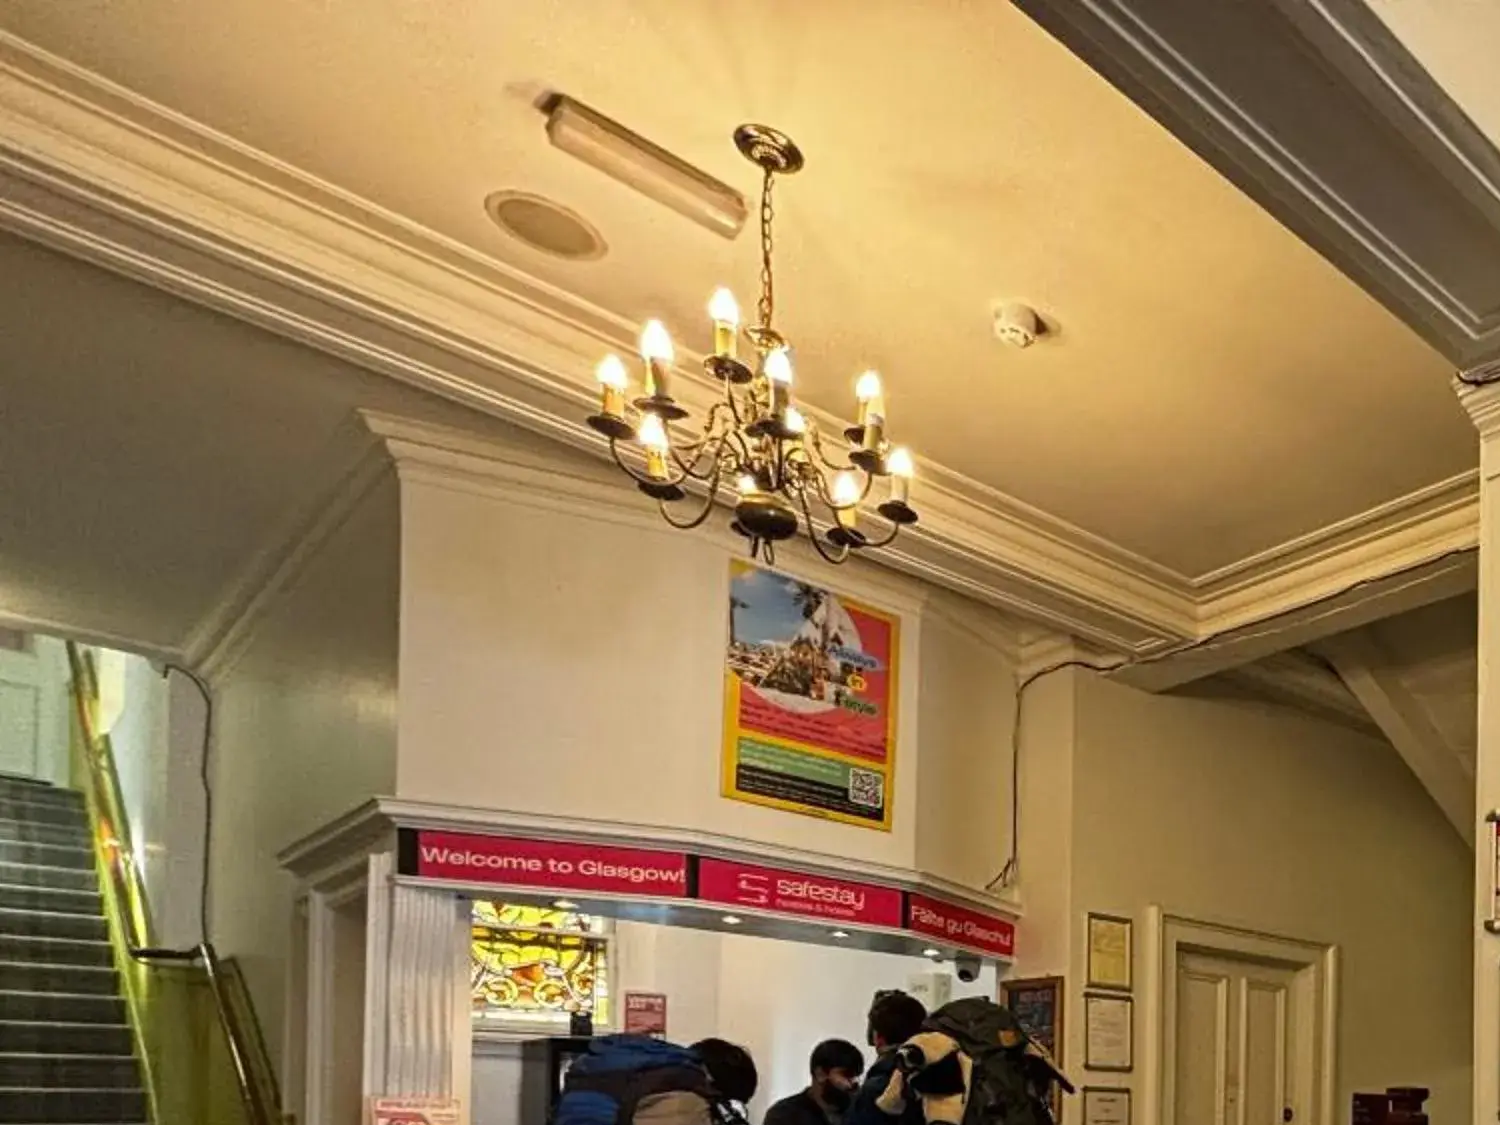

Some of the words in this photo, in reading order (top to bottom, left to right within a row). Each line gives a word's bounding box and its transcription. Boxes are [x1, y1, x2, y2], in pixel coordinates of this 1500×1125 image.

[420, 846, 543, 872] Welcome
[547, 857, 574, 874] to
[577, 859, 688, 883] Glasgow!
